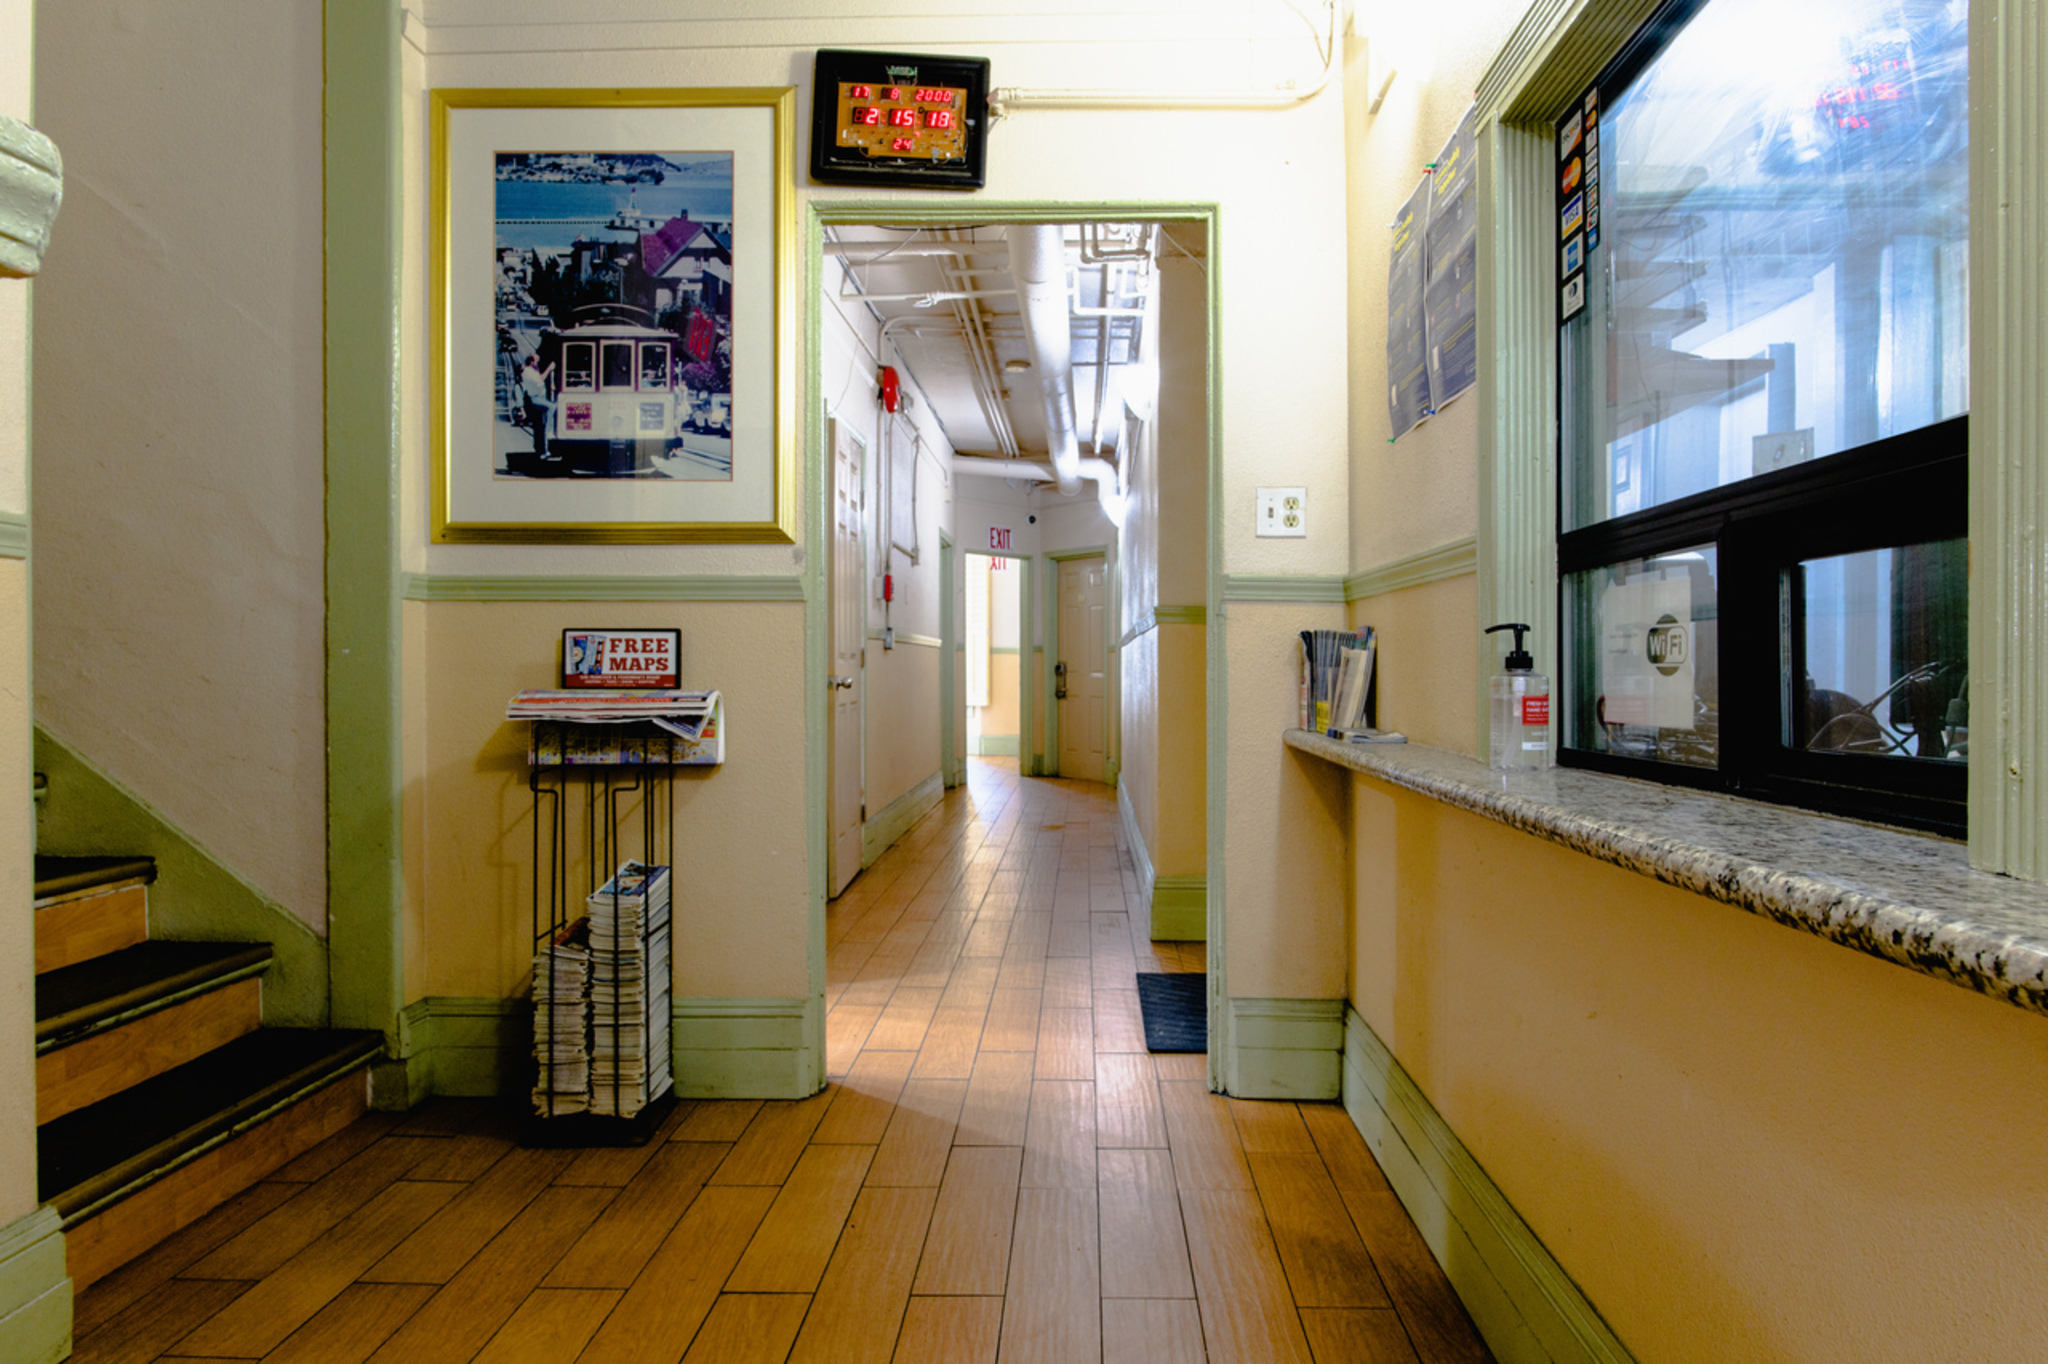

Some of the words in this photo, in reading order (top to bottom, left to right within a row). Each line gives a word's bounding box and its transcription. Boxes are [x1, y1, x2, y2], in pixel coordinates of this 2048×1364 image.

[854, 86, 870, 98] 17
[915, 88, 953, 103] 2000
[893, 137, 913, 151] 24
[990, 527, 1011, 550] EXIT
[609, 638, 669, 653] FREE
[609, 657, 669, 671] MAPS
